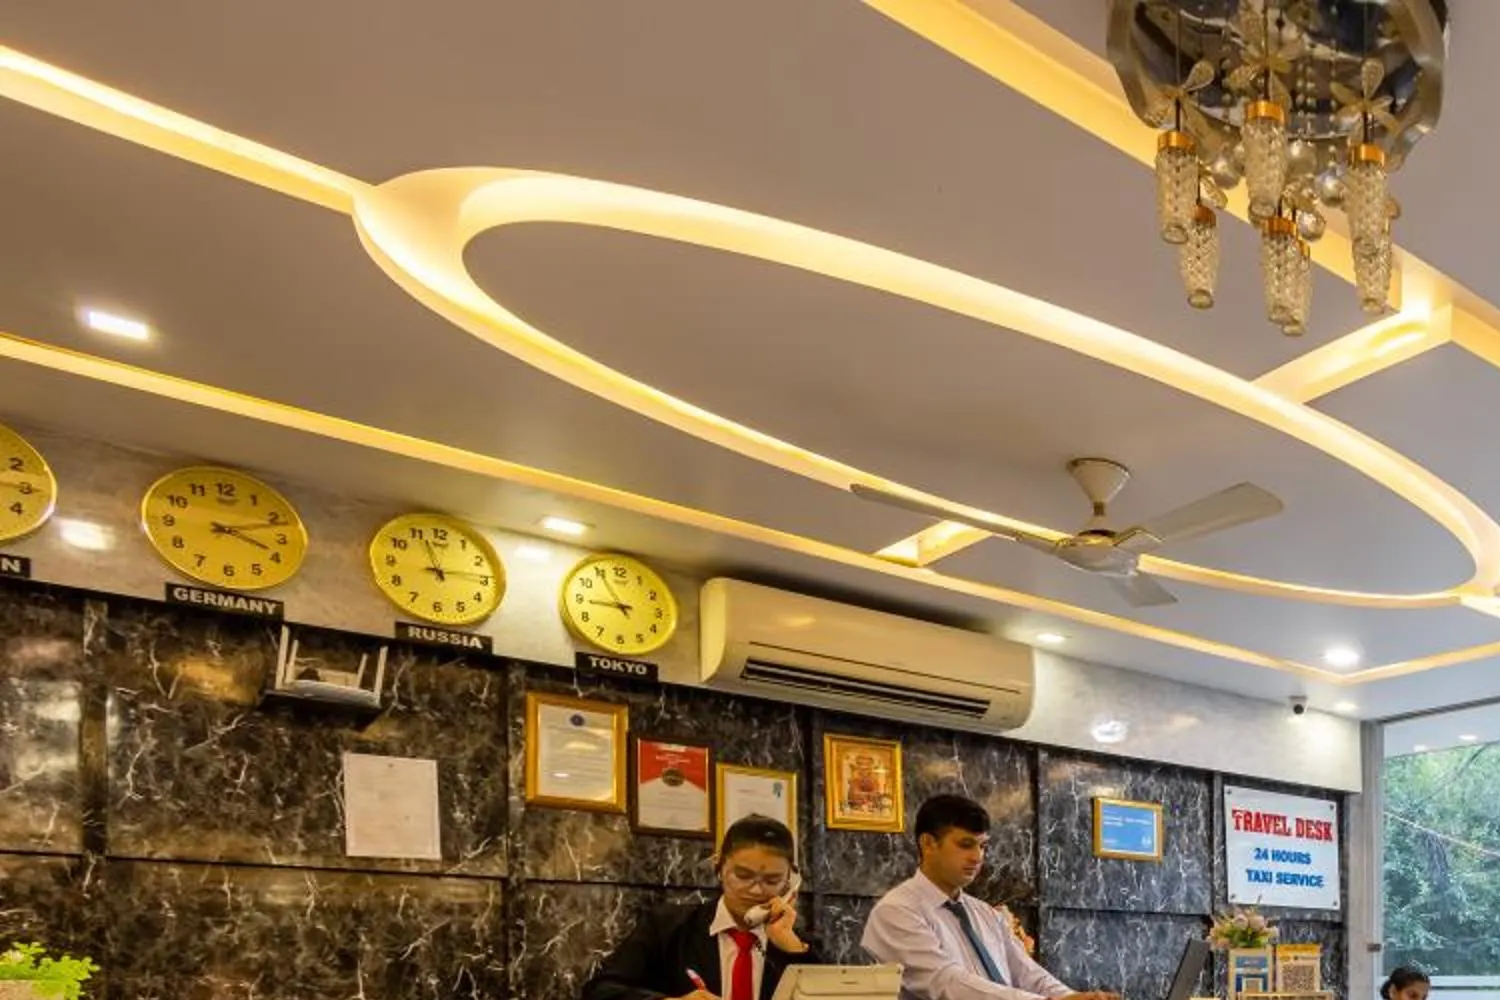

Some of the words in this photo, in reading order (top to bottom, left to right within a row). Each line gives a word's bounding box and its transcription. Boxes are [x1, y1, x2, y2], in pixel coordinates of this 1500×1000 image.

[9, 457, 25, 473] 2
[190, 483, 206, 497] 11
[216, 482, 236, 497] 12
[168, 495, 189, 509] 10
[250, 495, 258, 507] 1
[9, 502, 24, 516] 4
[162, 514, 176, 527] 9
[268, 511, 281, 524] 2
[276, 533, 288, 545] 3
[409, 527, 424, 540] 11
[433, 528, 449, 541] 12
[172, 535, 185, 549] 8
[391, 538, 408, 551] 10
[460, 539, 467, 550] 1
[193, 553, 206, 568] 7
[269, 551, 282, 564] 4
[384, 553, 397, 567] 9
[473, 555, 484, 567] 2
[223, 564, 235, 577] 6
[251, 563, 263, 576] 5
[612, 566, 628, 579] 12
[391, 574, 402, 587] 8
[479, 575, 490, 586] 3
[579, 577, 593, 590] 10
[636, 575, 643, 586] 1
[173, 587, 277, 615] GERMANY
[409, 591, 420, 604] 7
[472, 591, 483, 603] 4
[575, 593, 585, 605] 9
[433, 601, 443, 613] 6
[456, 601, 466, 613] 5
[581, 611, 590, 623] 8
[407, 626, 483, 649] RUSSIA
[595, 625, 605, 637] 7
[616, 634, 625, 645] 6
[635, 633, 645, 644] 5
[588, 656, 647, 675] TOKYO
[1231, 808, 1292, 837] TRAVEL
[1295, 817, 1334, 842] DESK
[1254, 847, 1269, 861] 24
[1271, 849, 1312, 866] HOURS
[1246, 868, 1273, 884] TAXI
[1275, 872, 1325, 889] SERVICE
